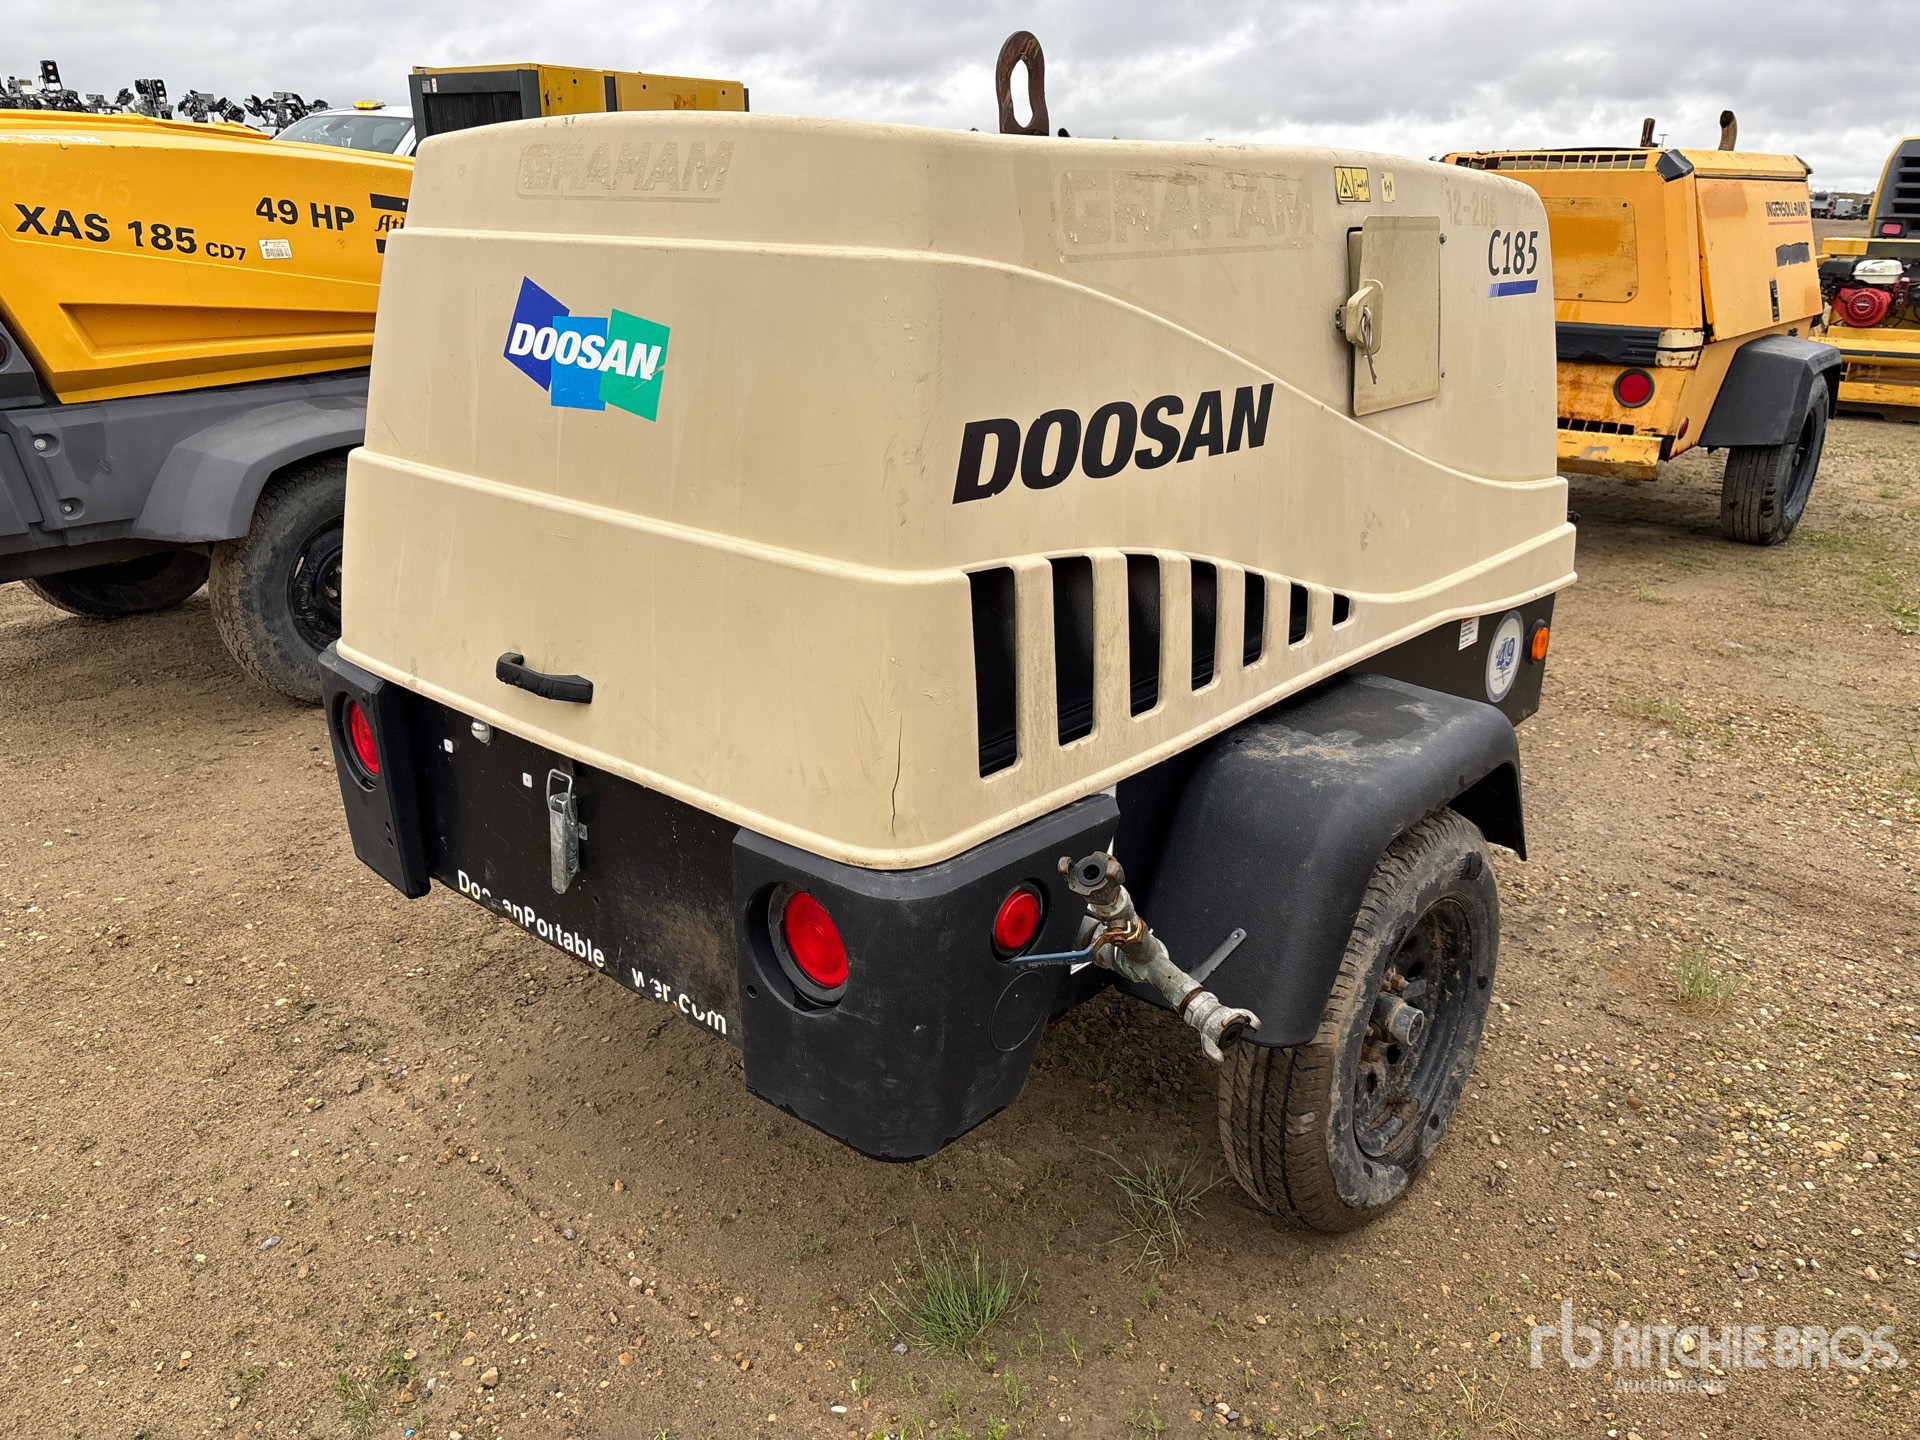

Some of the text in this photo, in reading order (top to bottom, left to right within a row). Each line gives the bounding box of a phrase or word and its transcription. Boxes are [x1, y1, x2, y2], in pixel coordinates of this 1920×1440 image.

[14, 203, 247, 262] XAS 185 CD7
[255, 196, 355, 232] 49 HP
[1488, 229, 1539, 277] C185
[508, 322, 662, 381] DOOSAN
[952, 382, 1275, 505] DOOSAN
